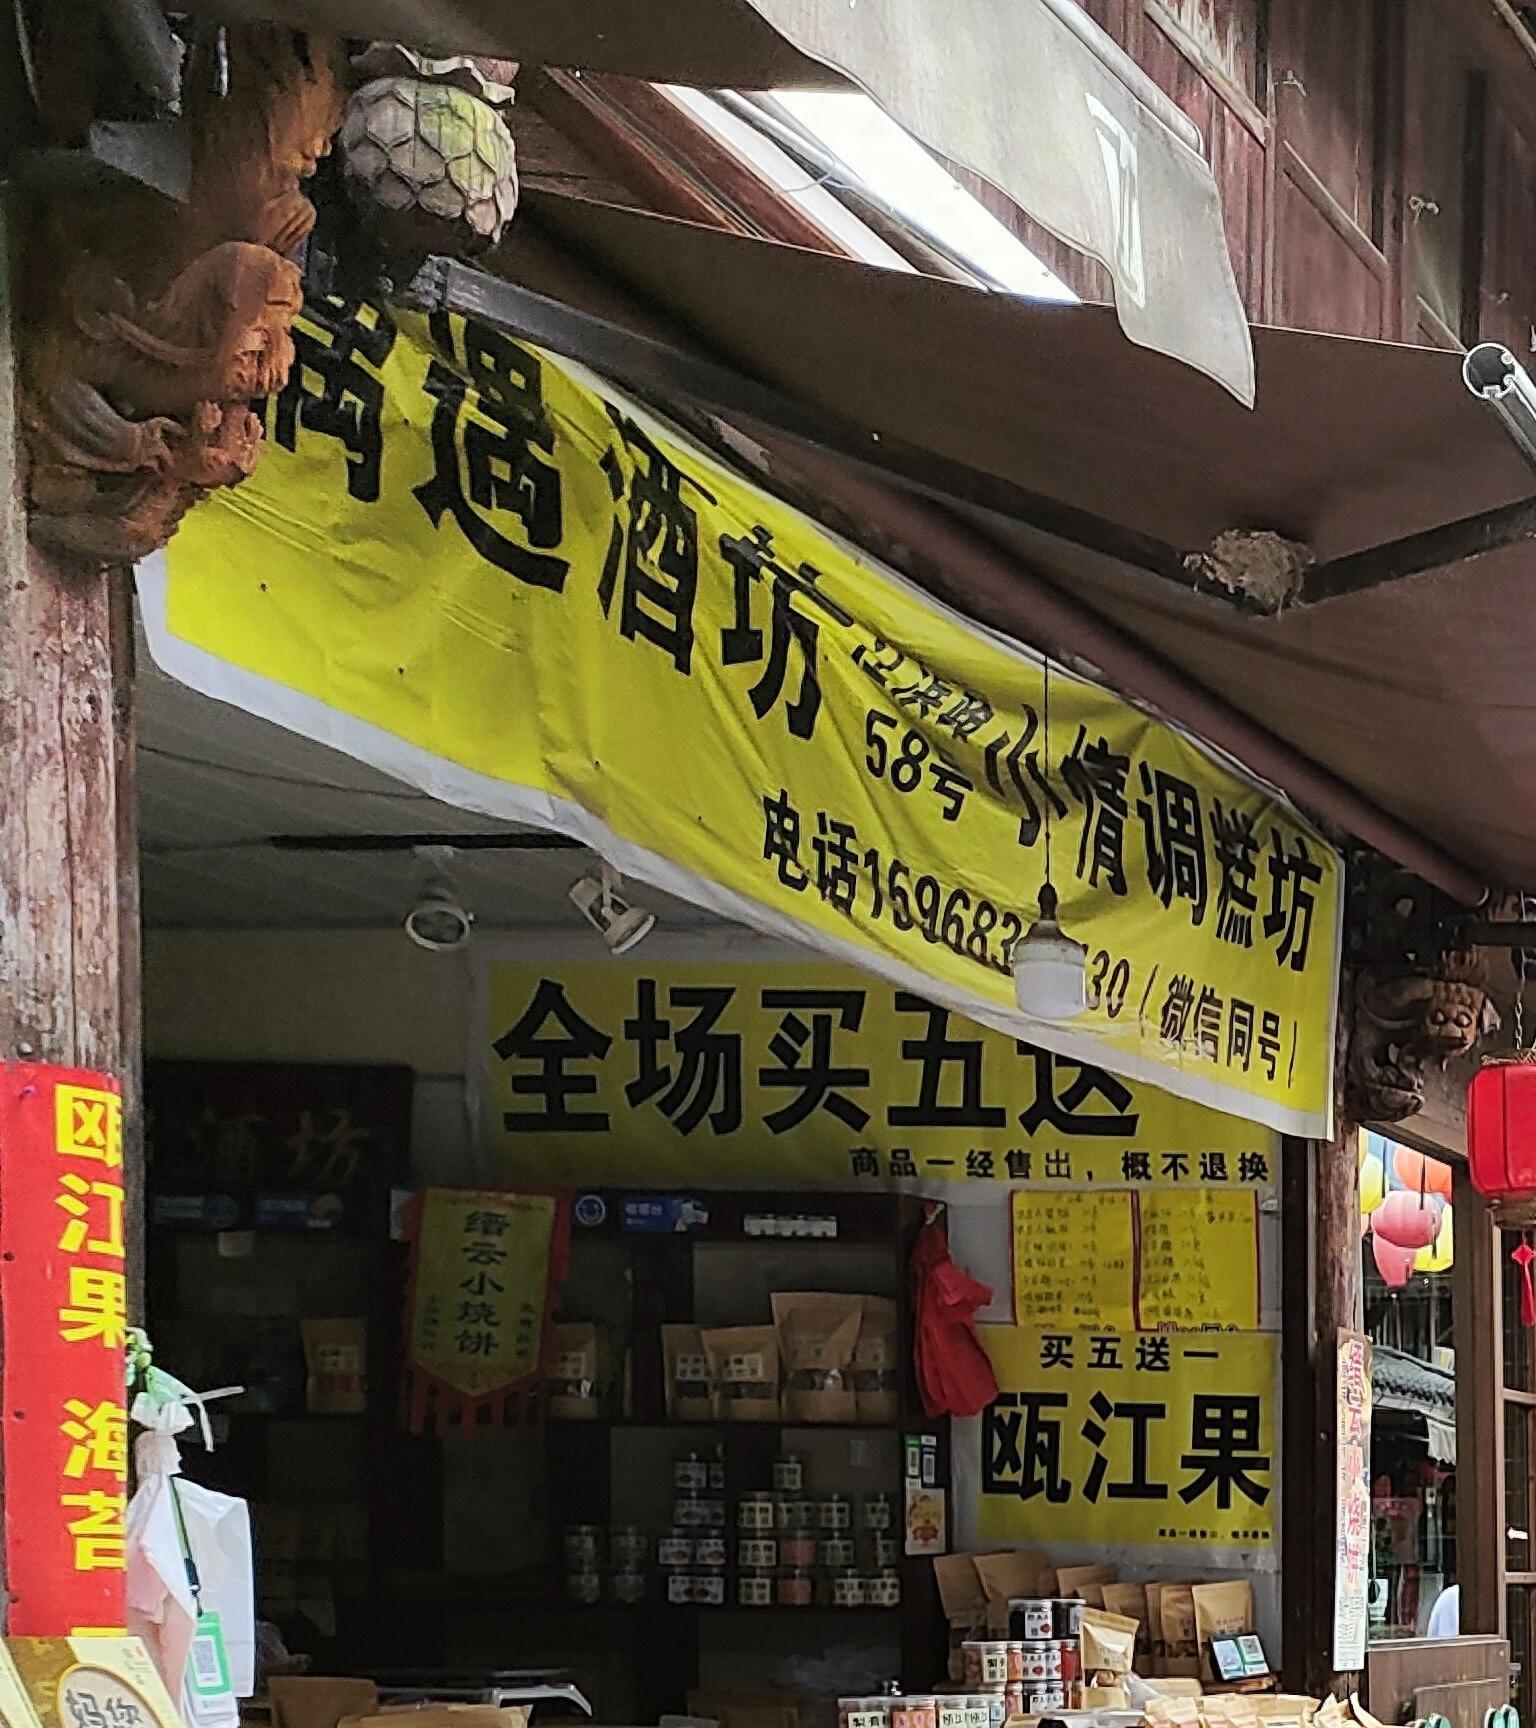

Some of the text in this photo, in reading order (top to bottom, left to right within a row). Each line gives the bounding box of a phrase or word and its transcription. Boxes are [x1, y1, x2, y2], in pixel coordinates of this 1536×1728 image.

[984, 703, 1324, 972] 小情调糕坊
[1040, 1335, 1220, 1372] 买五送一
[981, 1390, 1271, 1510] 瓯江果
